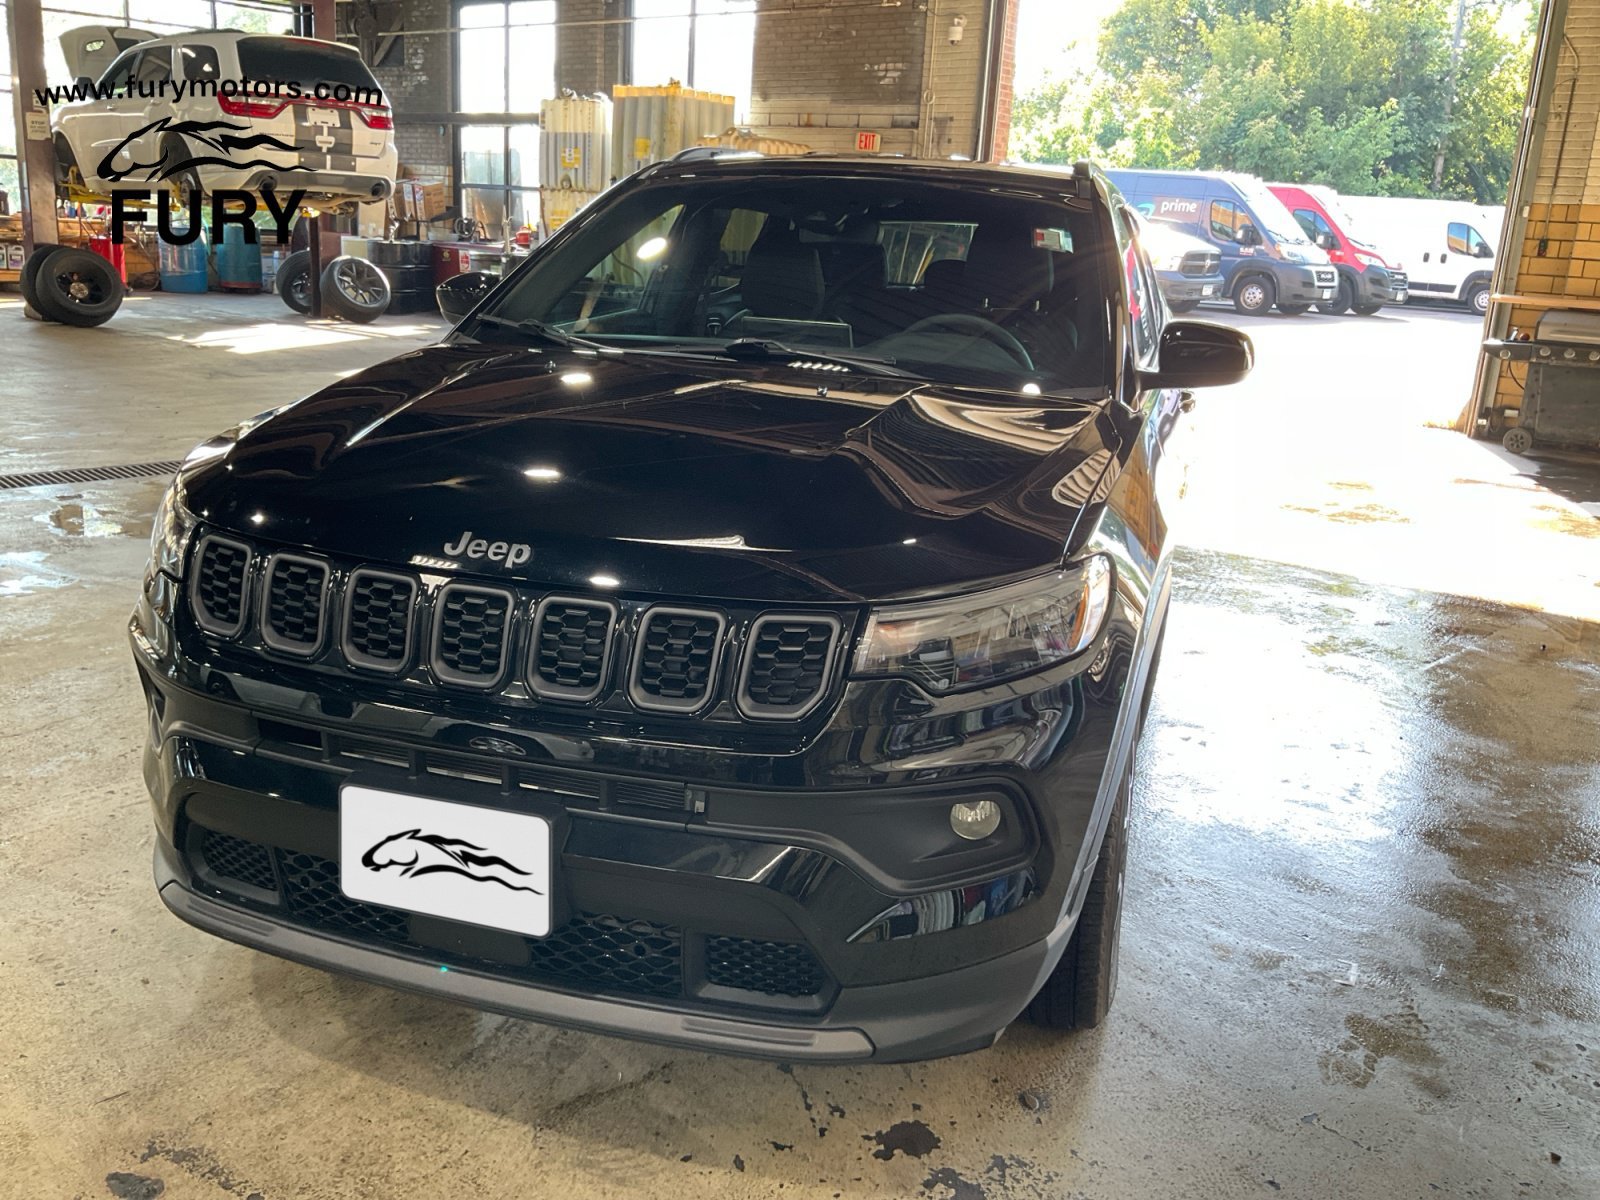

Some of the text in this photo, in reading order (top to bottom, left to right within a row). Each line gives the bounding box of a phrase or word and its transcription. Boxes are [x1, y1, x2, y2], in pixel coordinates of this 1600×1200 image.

[858, 133, 876, 150] EXIT
[1160, 199, 1198, 214] prime
[443, 531, 532, 570] Jeep
